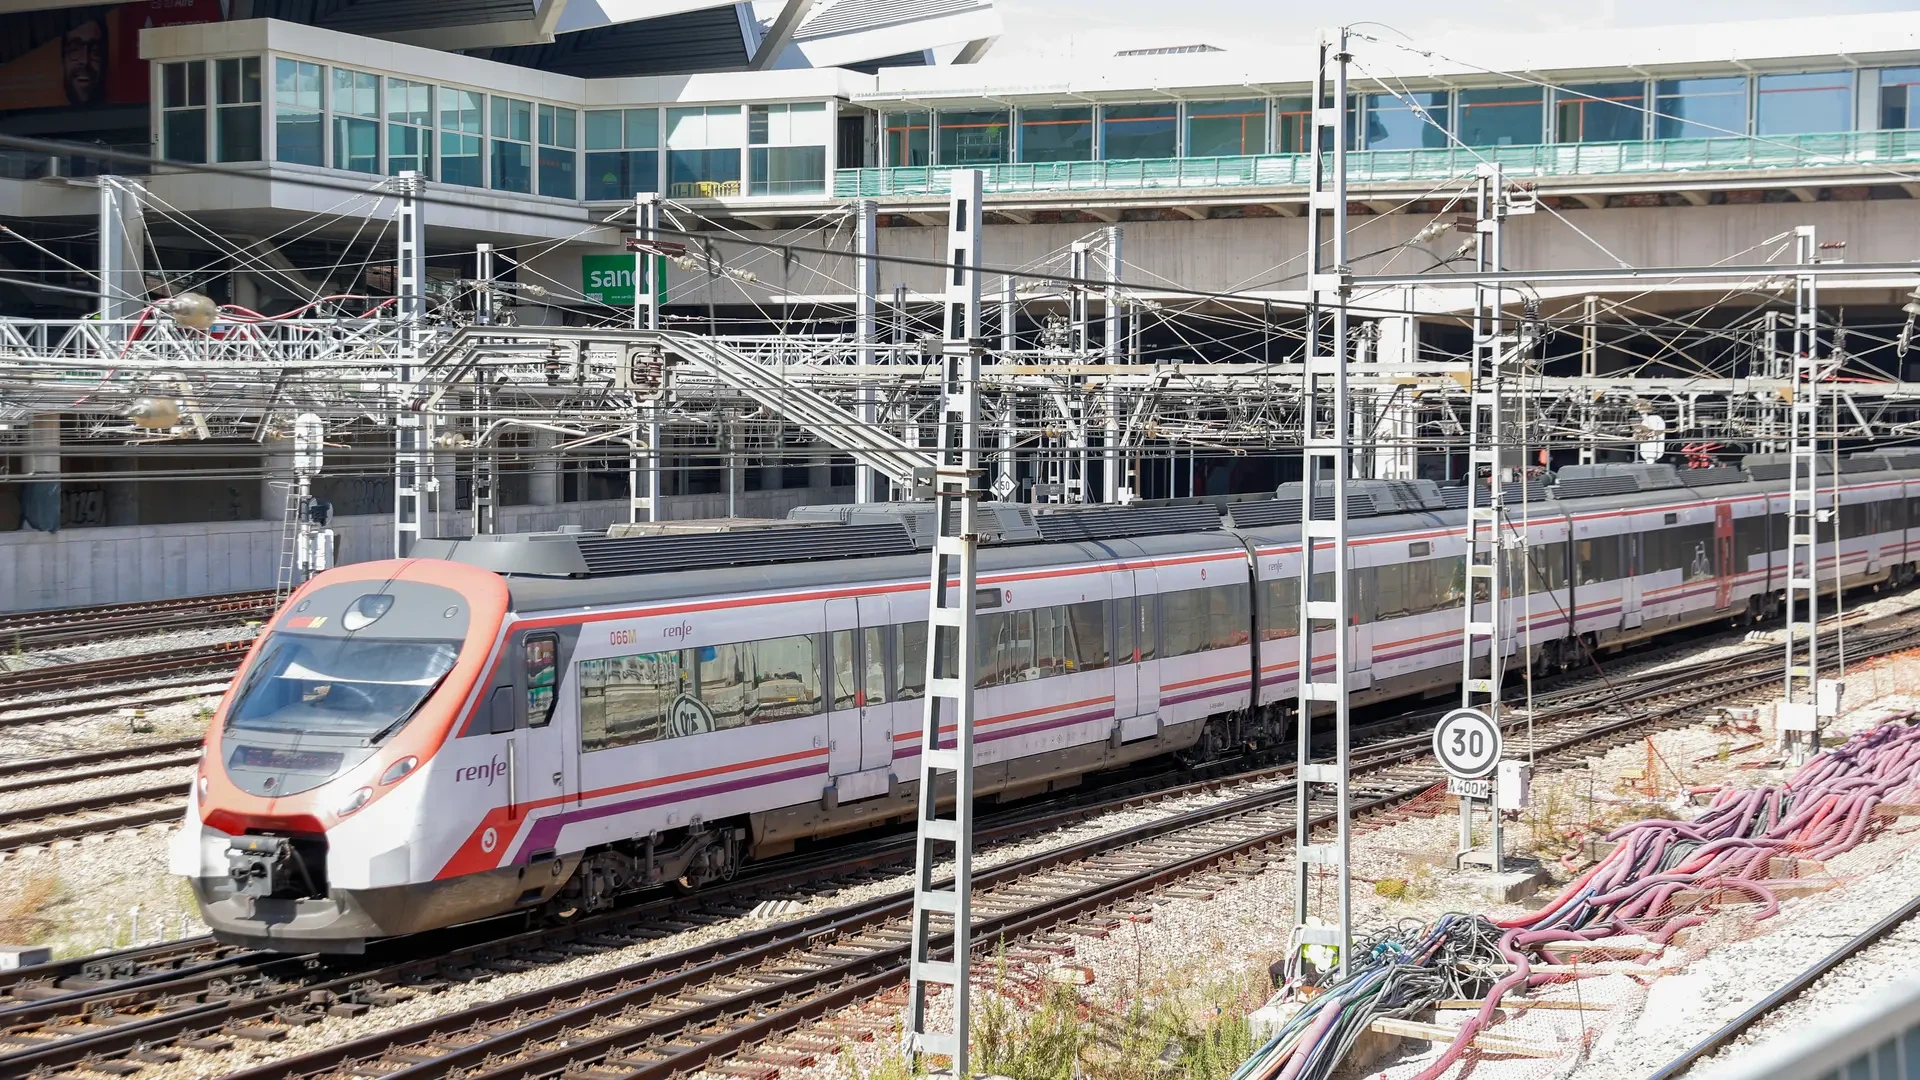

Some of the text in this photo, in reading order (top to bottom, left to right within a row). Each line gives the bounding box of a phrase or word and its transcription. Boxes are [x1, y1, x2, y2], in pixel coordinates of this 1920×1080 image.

[610, 620, 692, 645] 066M renfe
[1452, 728, 1483, 757] 30
[455, 753, 507, 787] renfe
